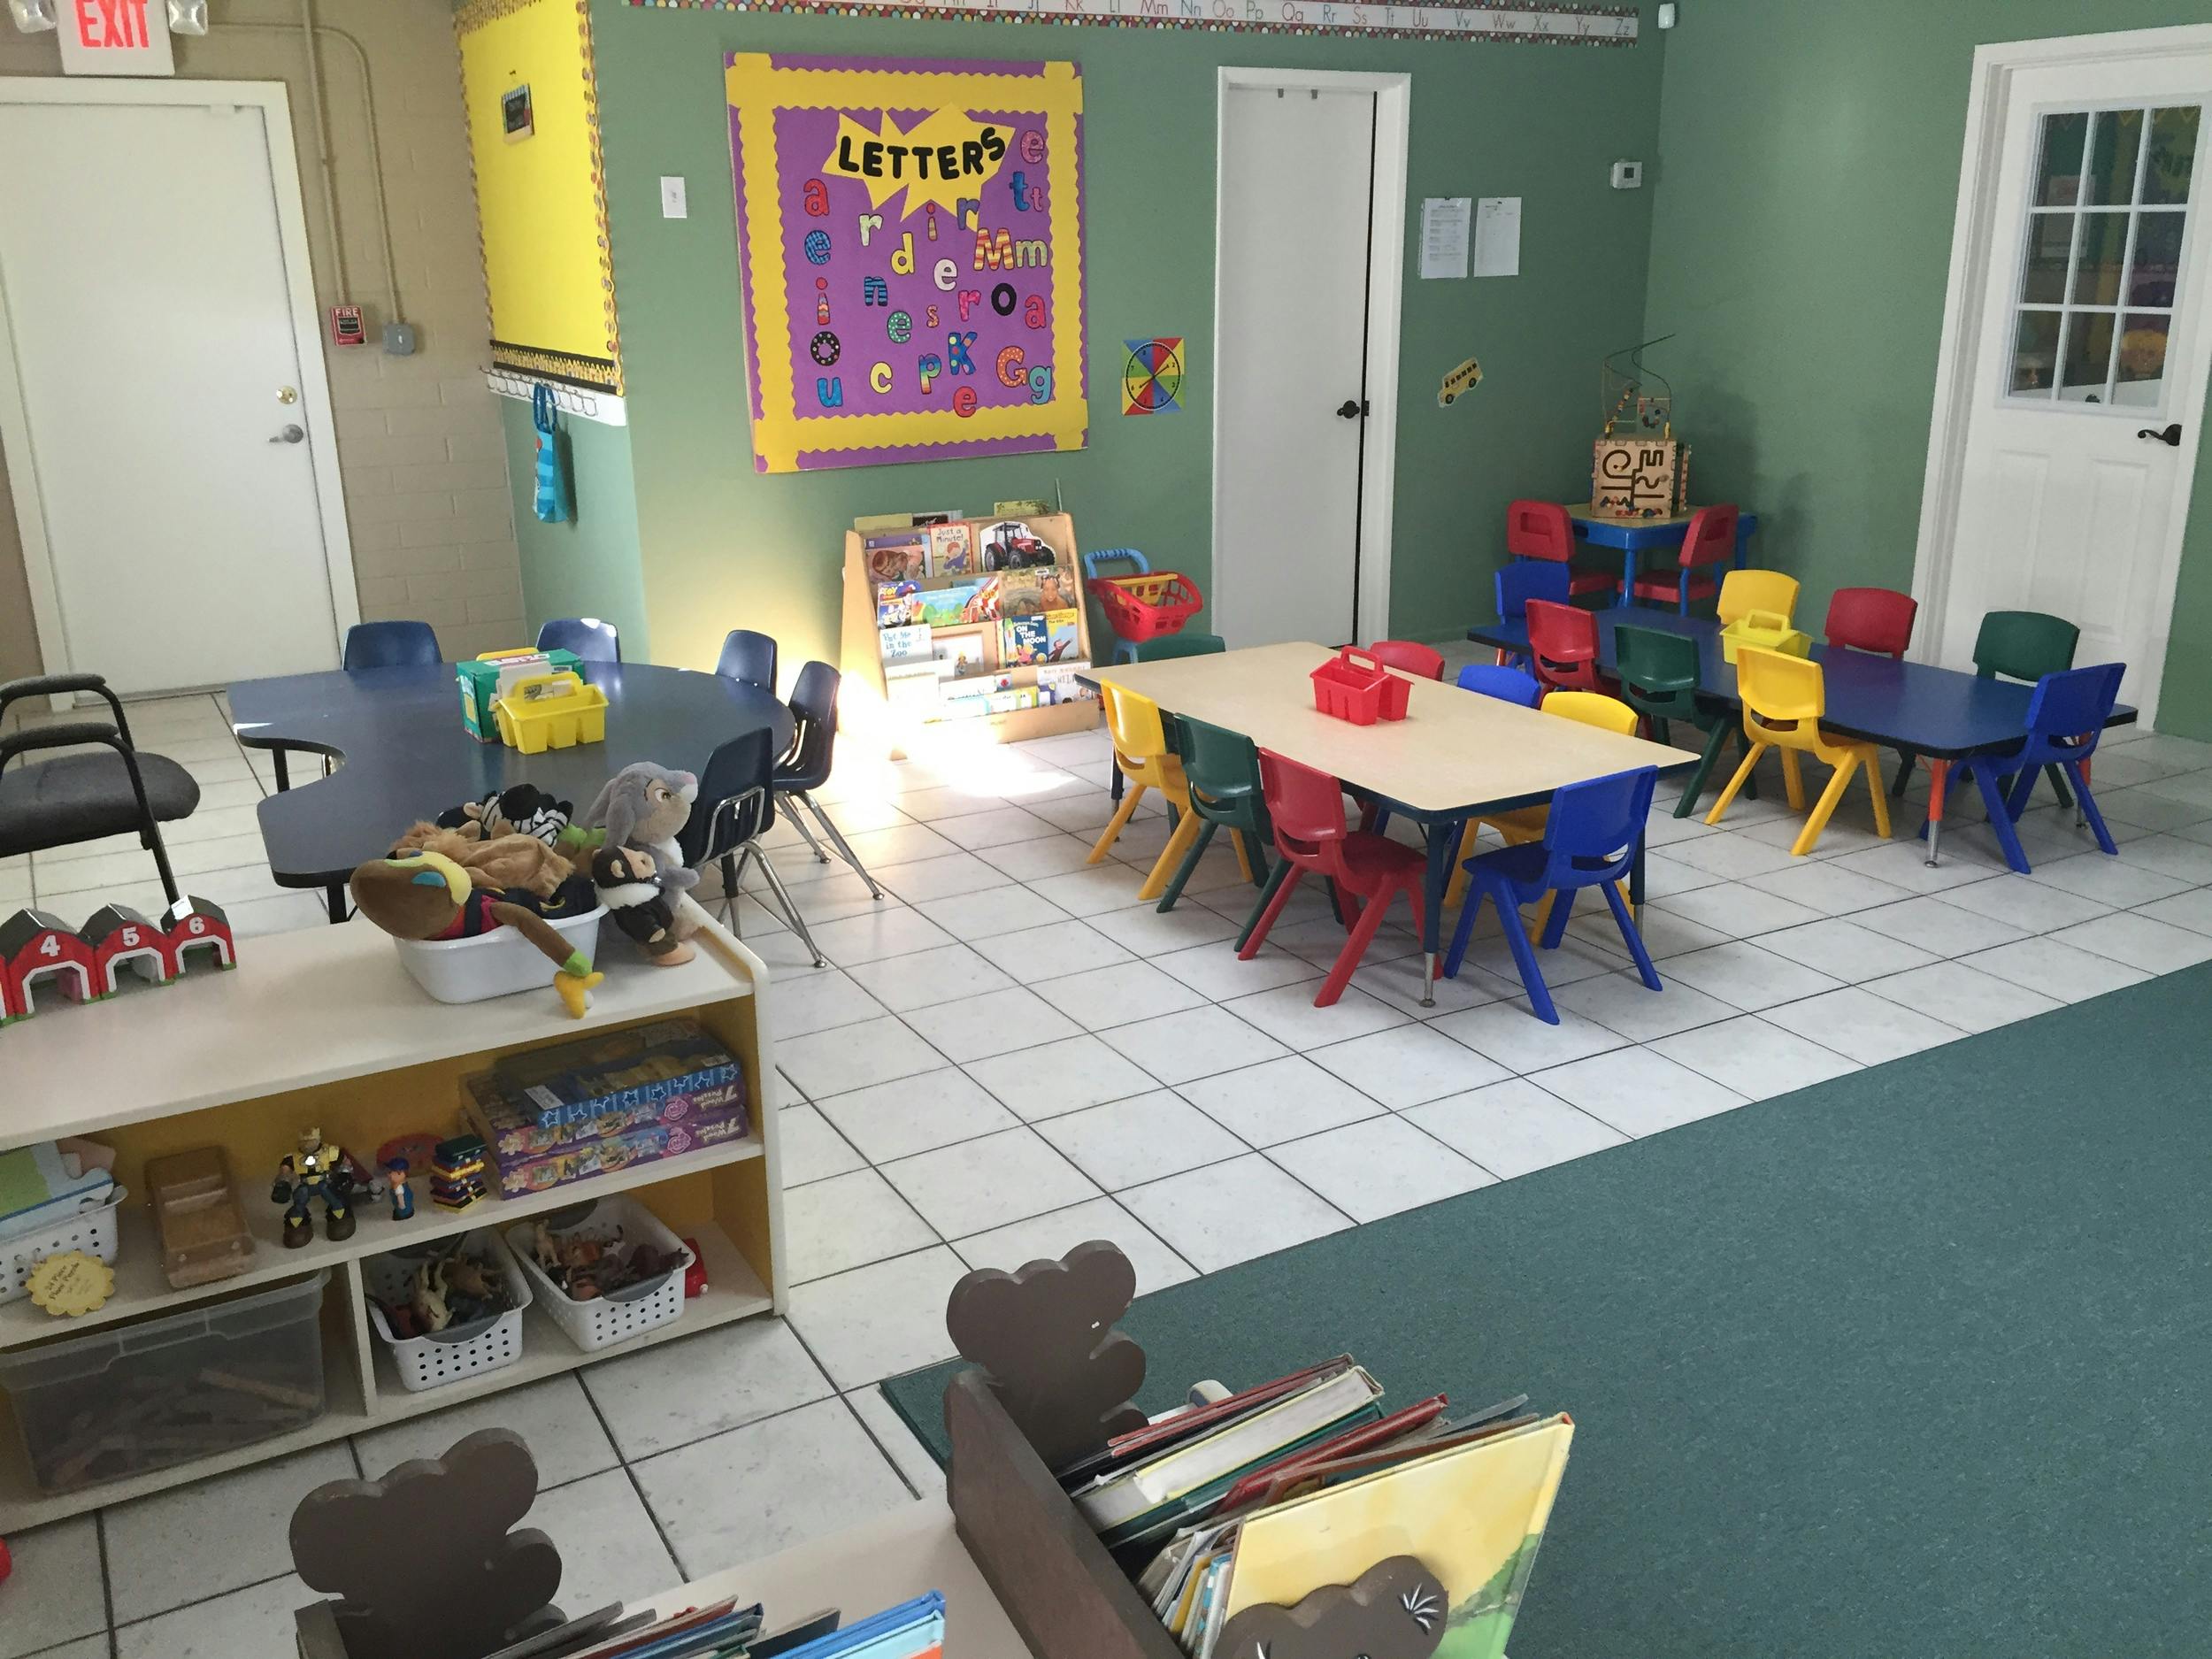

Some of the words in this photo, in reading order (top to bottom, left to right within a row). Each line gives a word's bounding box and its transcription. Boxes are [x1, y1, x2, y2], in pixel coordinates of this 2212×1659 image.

[73, 0, 150, 48] EXIT
[1180, 0, 1202, 16] Nn
[1212, 0, 1234, 18] Oo
[1246, 0, 1263, 21] Pp
[1282, 3, 1303, 24] Qq
[1323, 4, 1336, 23] Rr
[1353, 6, 1367, 25] Ss
[1385, 7, 1394, 27] Tt
[1412, 8, 1428, 27] Uu
[1454, 11, 1471, 28] Vv
[1493, 13, 1516, 29] Ww
[1533, 14, 1549, 31] Xx
[1575, 16, 1590, 36] Yy
[1615, 18, 1630, 36] Zz
[838, 127, 1006, 180] LETTERS
[1020, 130, 1044, 164] e
[803, 178, 830, 217] a
[1010, 171, 1027, 211] t
[1030, 187, 1044, 211] t
[858, 213, 884, 247] r
[926, 203, 938, 241] i
[956, 197, 979, 230] r
[804, 229, 831, 265] e
[889, 231, 915, 275] d
[973, 227, 1048, 271] Mm
[933, 257, 958, 291] e
[816, 277, 831, 326] i
[864, 276, 888, 307] n
[958, 289, 981, 322] r
[335, 307, 359, 318] FIRE
[887, 311, 912, 343] e
[1025, 295, 1046, 329] a
[918, 353, 941, 395] p
[996, 345, 1053, 405] Gg
[953, 385, 978, 418] e
[1016, 625, 1028, 634] ON
[1023, 636, 1047, 645] MOON
[122, 926, 140, 947] 5
[188, 917, 205, 934] 6
[40, 934, 60, 957] 4
